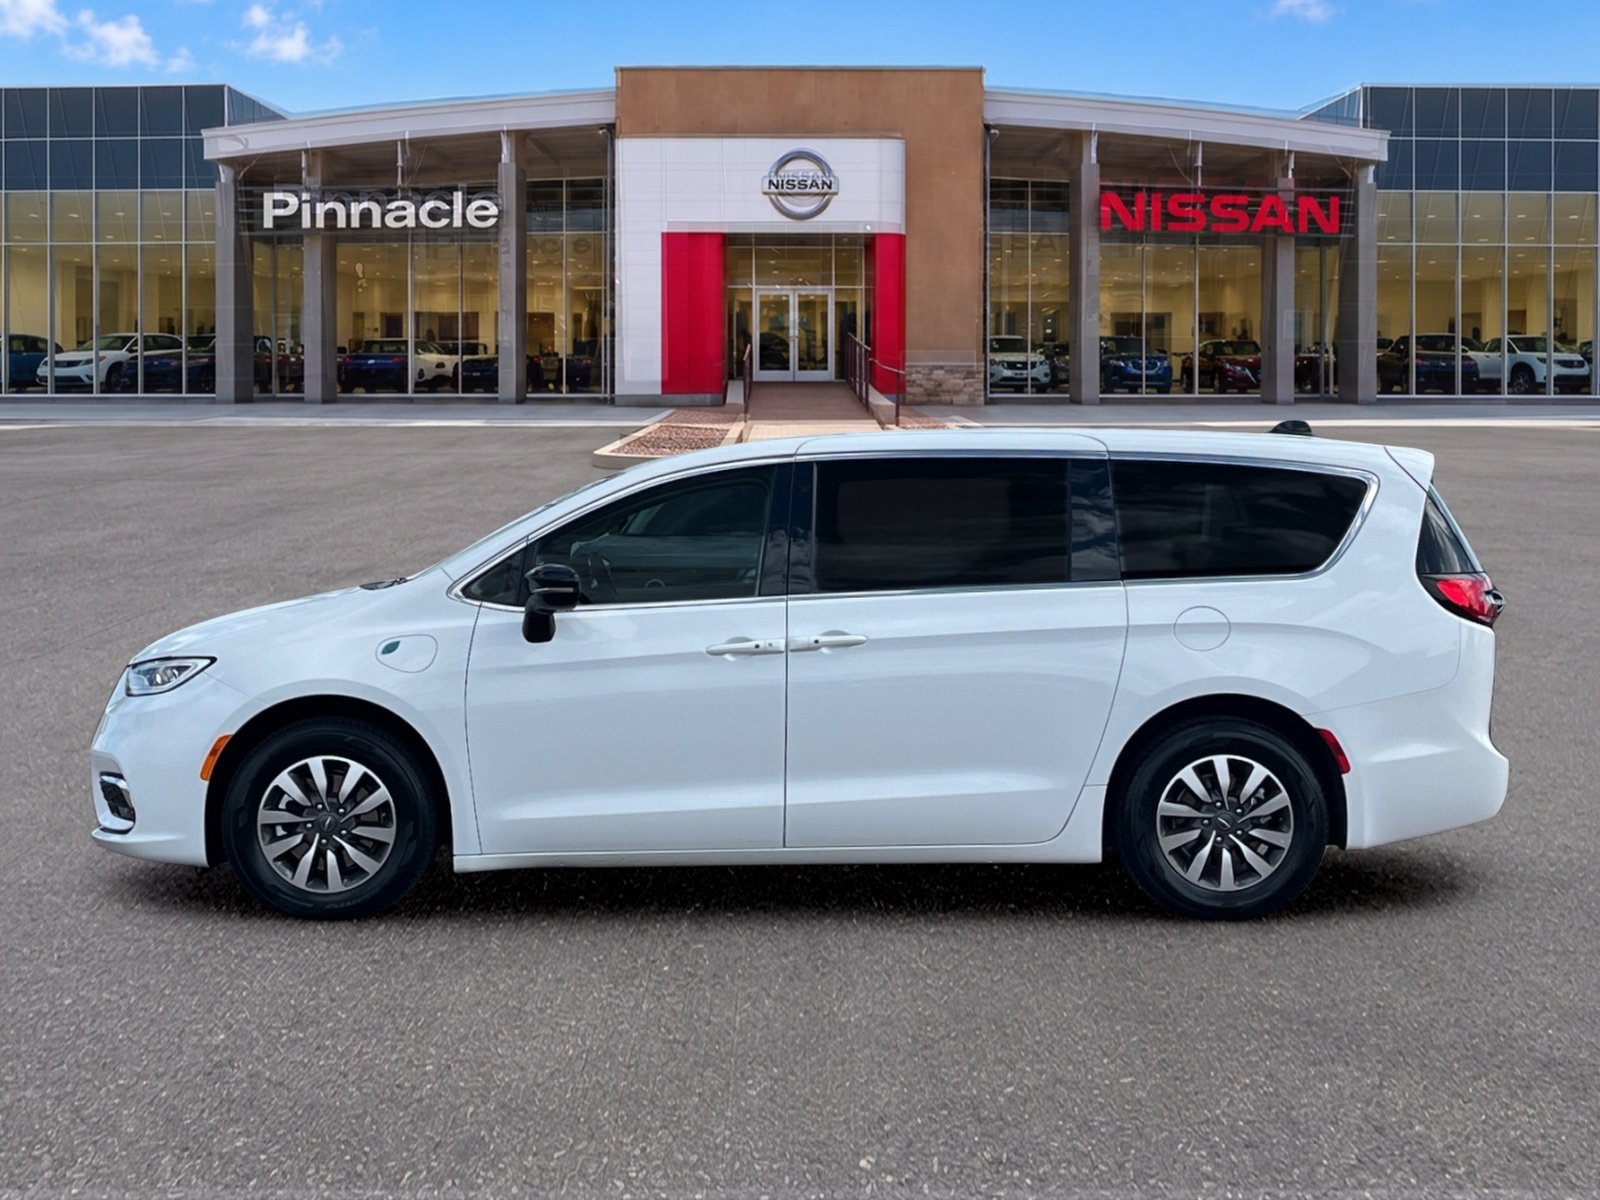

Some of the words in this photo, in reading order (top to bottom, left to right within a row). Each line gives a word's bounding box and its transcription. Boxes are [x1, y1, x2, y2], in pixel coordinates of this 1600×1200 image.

[768, 179, 833, 190] NISSAN
[263, 191, 499, 229] Pinnacle
[1100, 192, 1340, 234] NISSAN
